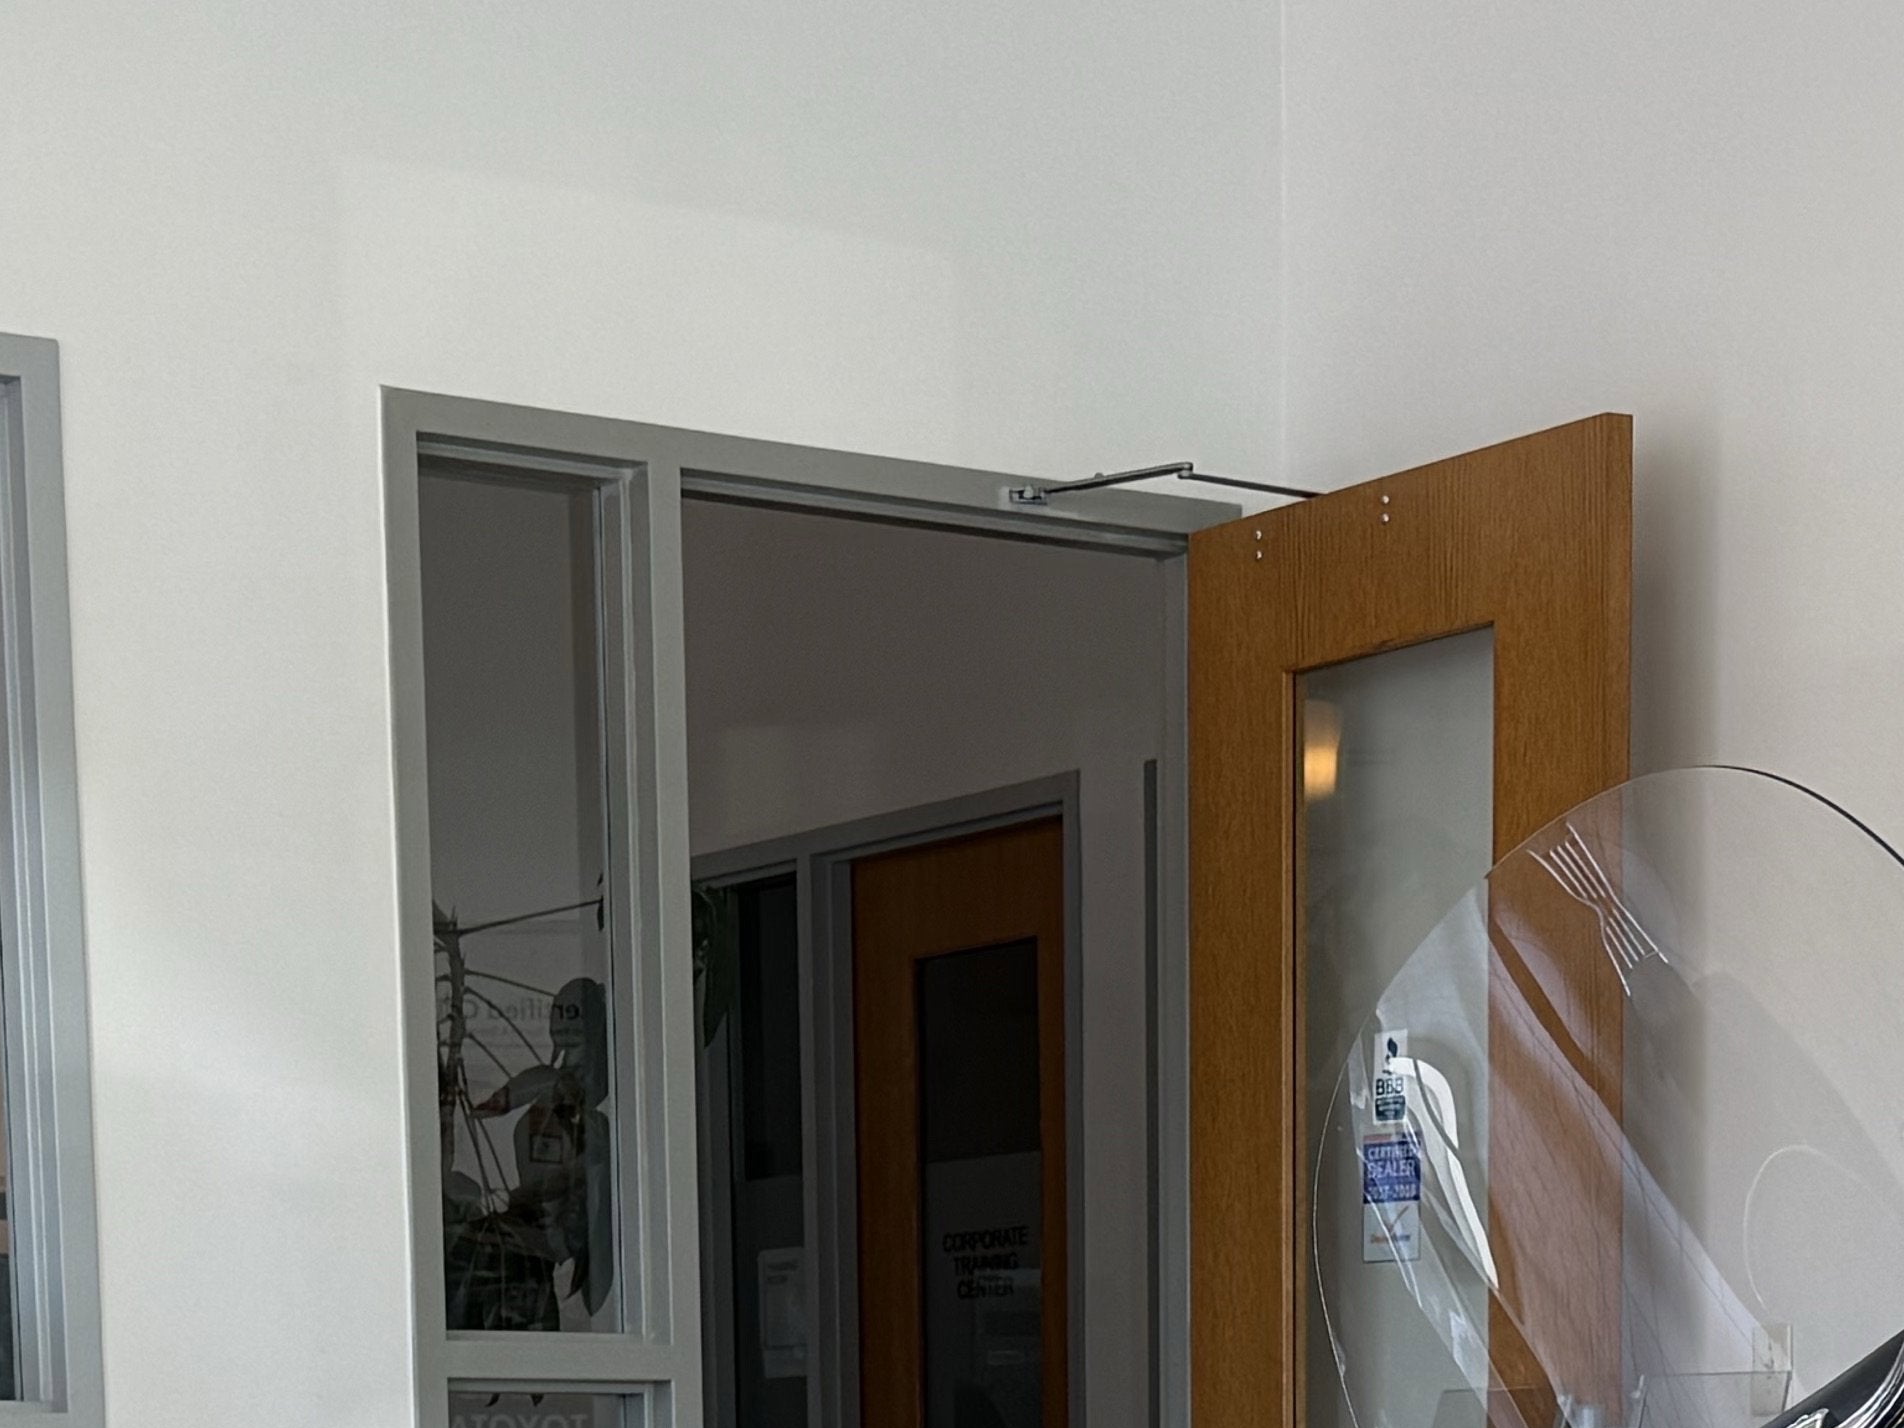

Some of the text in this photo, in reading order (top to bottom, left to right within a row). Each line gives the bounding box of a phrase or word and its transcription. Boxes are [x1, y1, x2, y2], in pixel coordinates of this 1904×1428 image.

[1376, 1077, 1404, 1096] BBB
[1367, 1160, 1415, 1178] DEALER
[943, 1226, 1029, 1252] CORPORATE
[954, 1253, 1018, 1275] TRAINING
[957, 1279, 1015, 1300] CENTER
